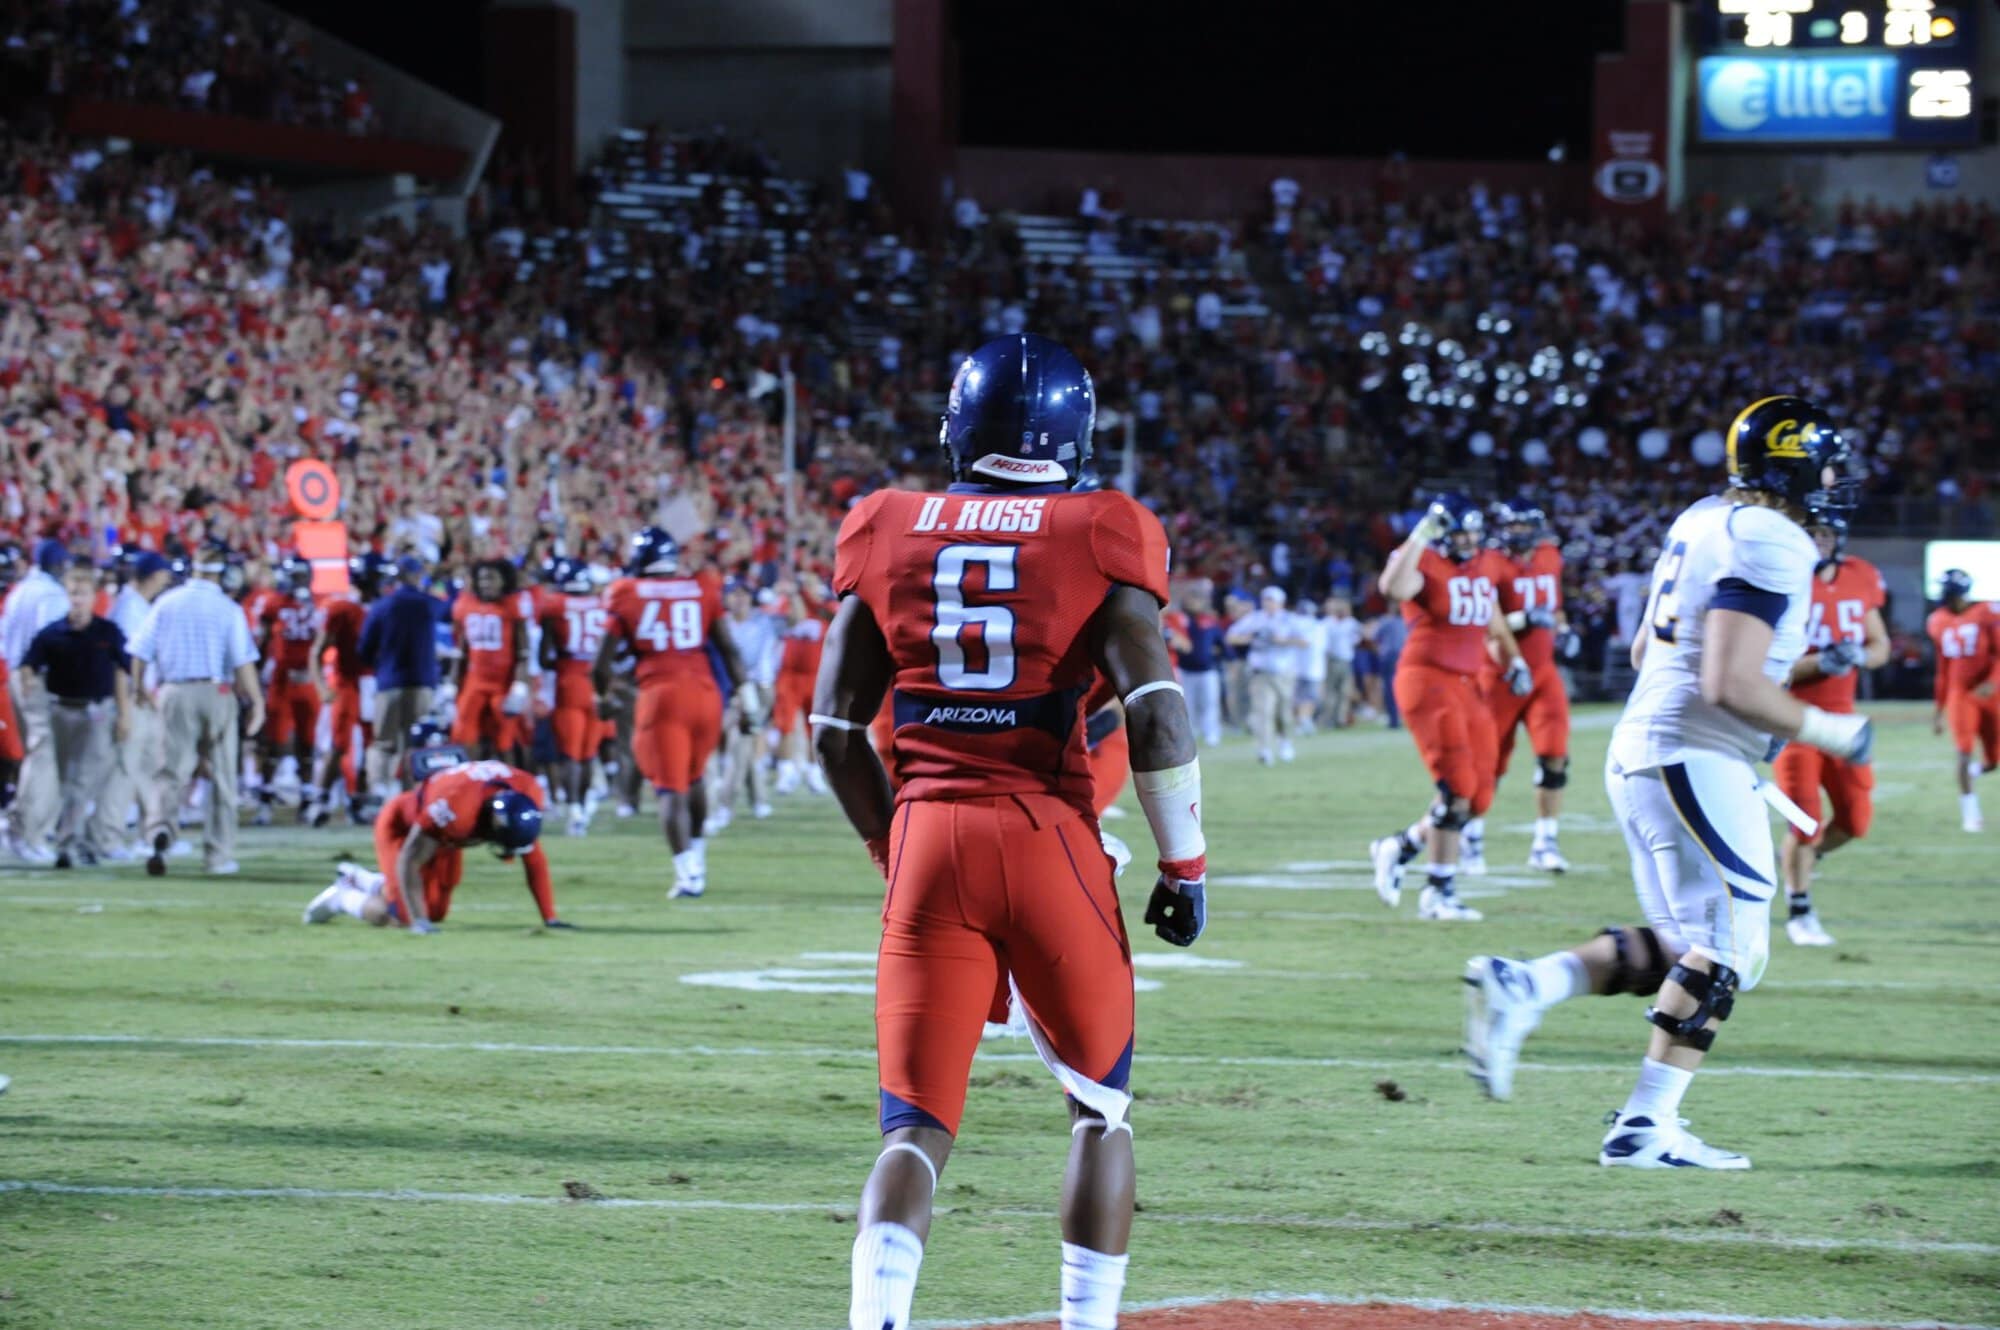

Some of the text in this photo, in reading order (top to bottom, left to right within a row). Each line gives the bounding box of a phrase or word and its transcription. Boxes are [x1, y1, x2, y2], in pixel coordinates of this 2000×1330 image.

[1039, 432, 1049, 446] 6
[991, 458, 1050, 474] ARIZONA
[914, 497, 1048, 533] D. ROSS
[1448, 576, 1493, 626] 66
[1513, 574, 1557, 613] 77
[636, 600, 703, 652] 49
[930, 543, 1019, 692] 6
[924, 706, 1016, 726] ARIZONA
